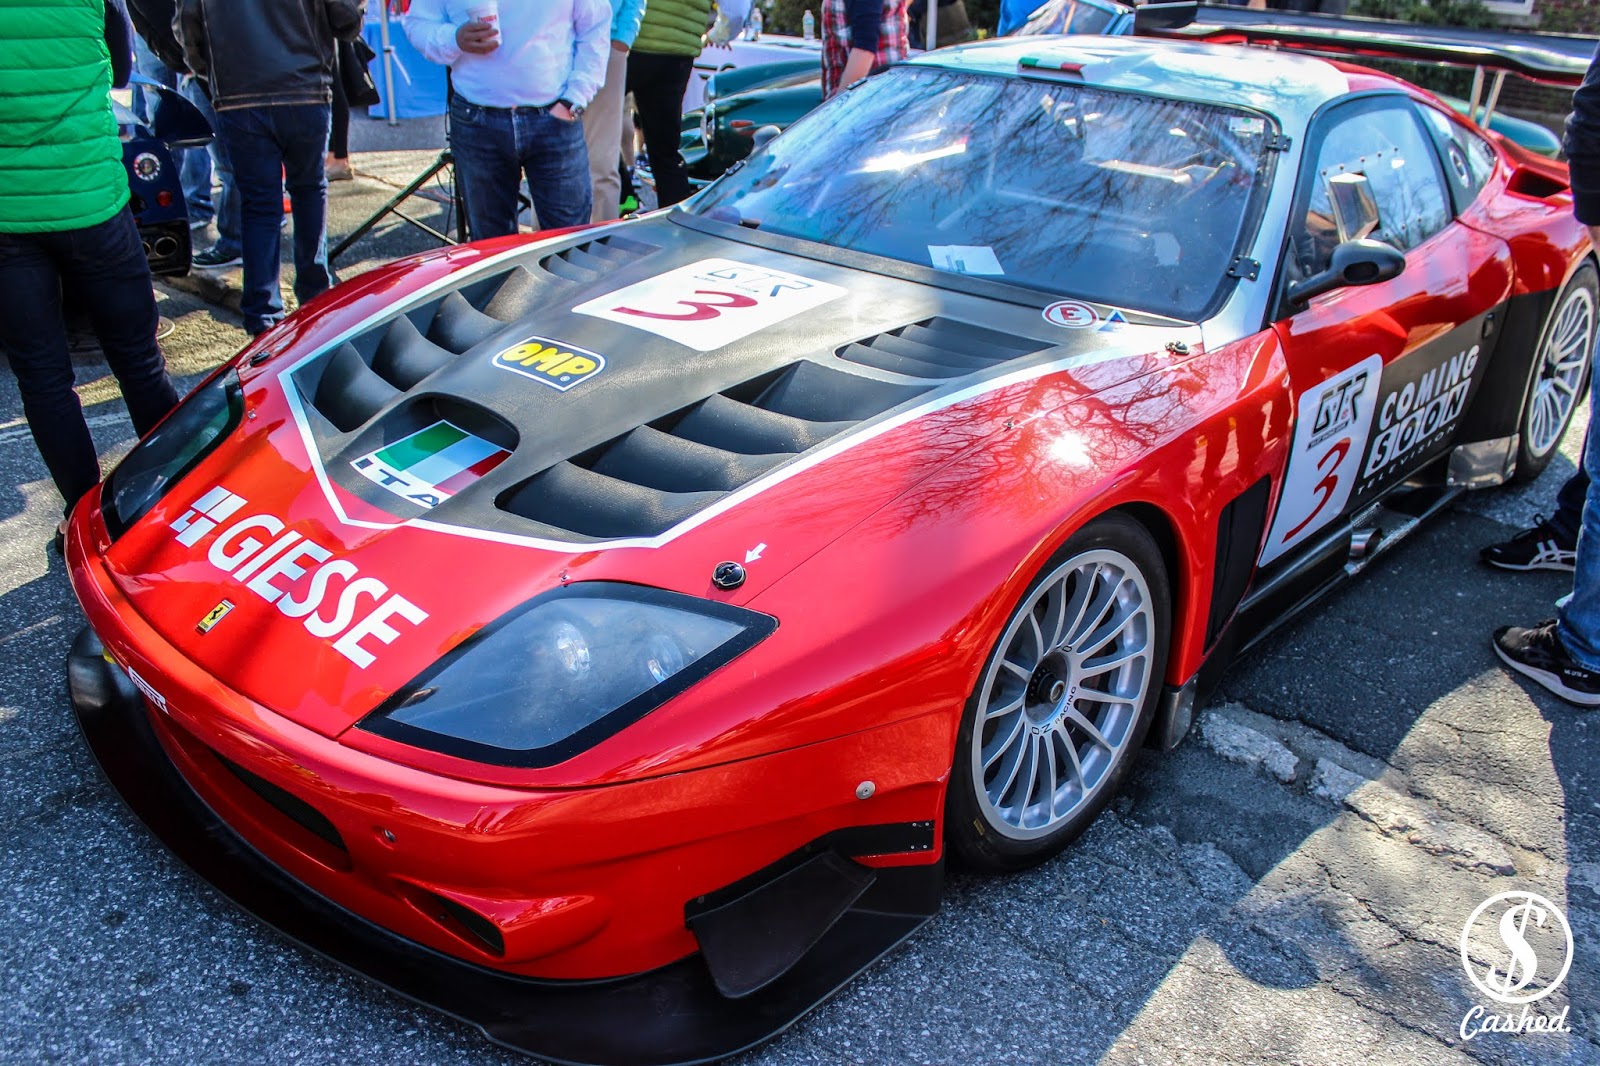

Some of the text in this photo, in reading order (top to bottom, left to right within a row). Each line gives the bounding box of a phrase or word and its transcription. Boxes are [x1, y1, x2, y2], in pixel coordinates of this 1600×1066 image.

[610, 289, 759, 322] 3
[1060, 306, 1082, 321] E
[501, 342, 597, 377] OMP
[1379, 345, 1480, 431] COMING
[1357, 423, 1457, 496] TELEVISION
[1363, 378, 1471, 480] SOON
[354, 456, 441, 508] ITA
[1281, 436, 1352, 545] 3
[207, 513, 430, 671] GIESSE
[1054, 686, 1077, 725] RACING
